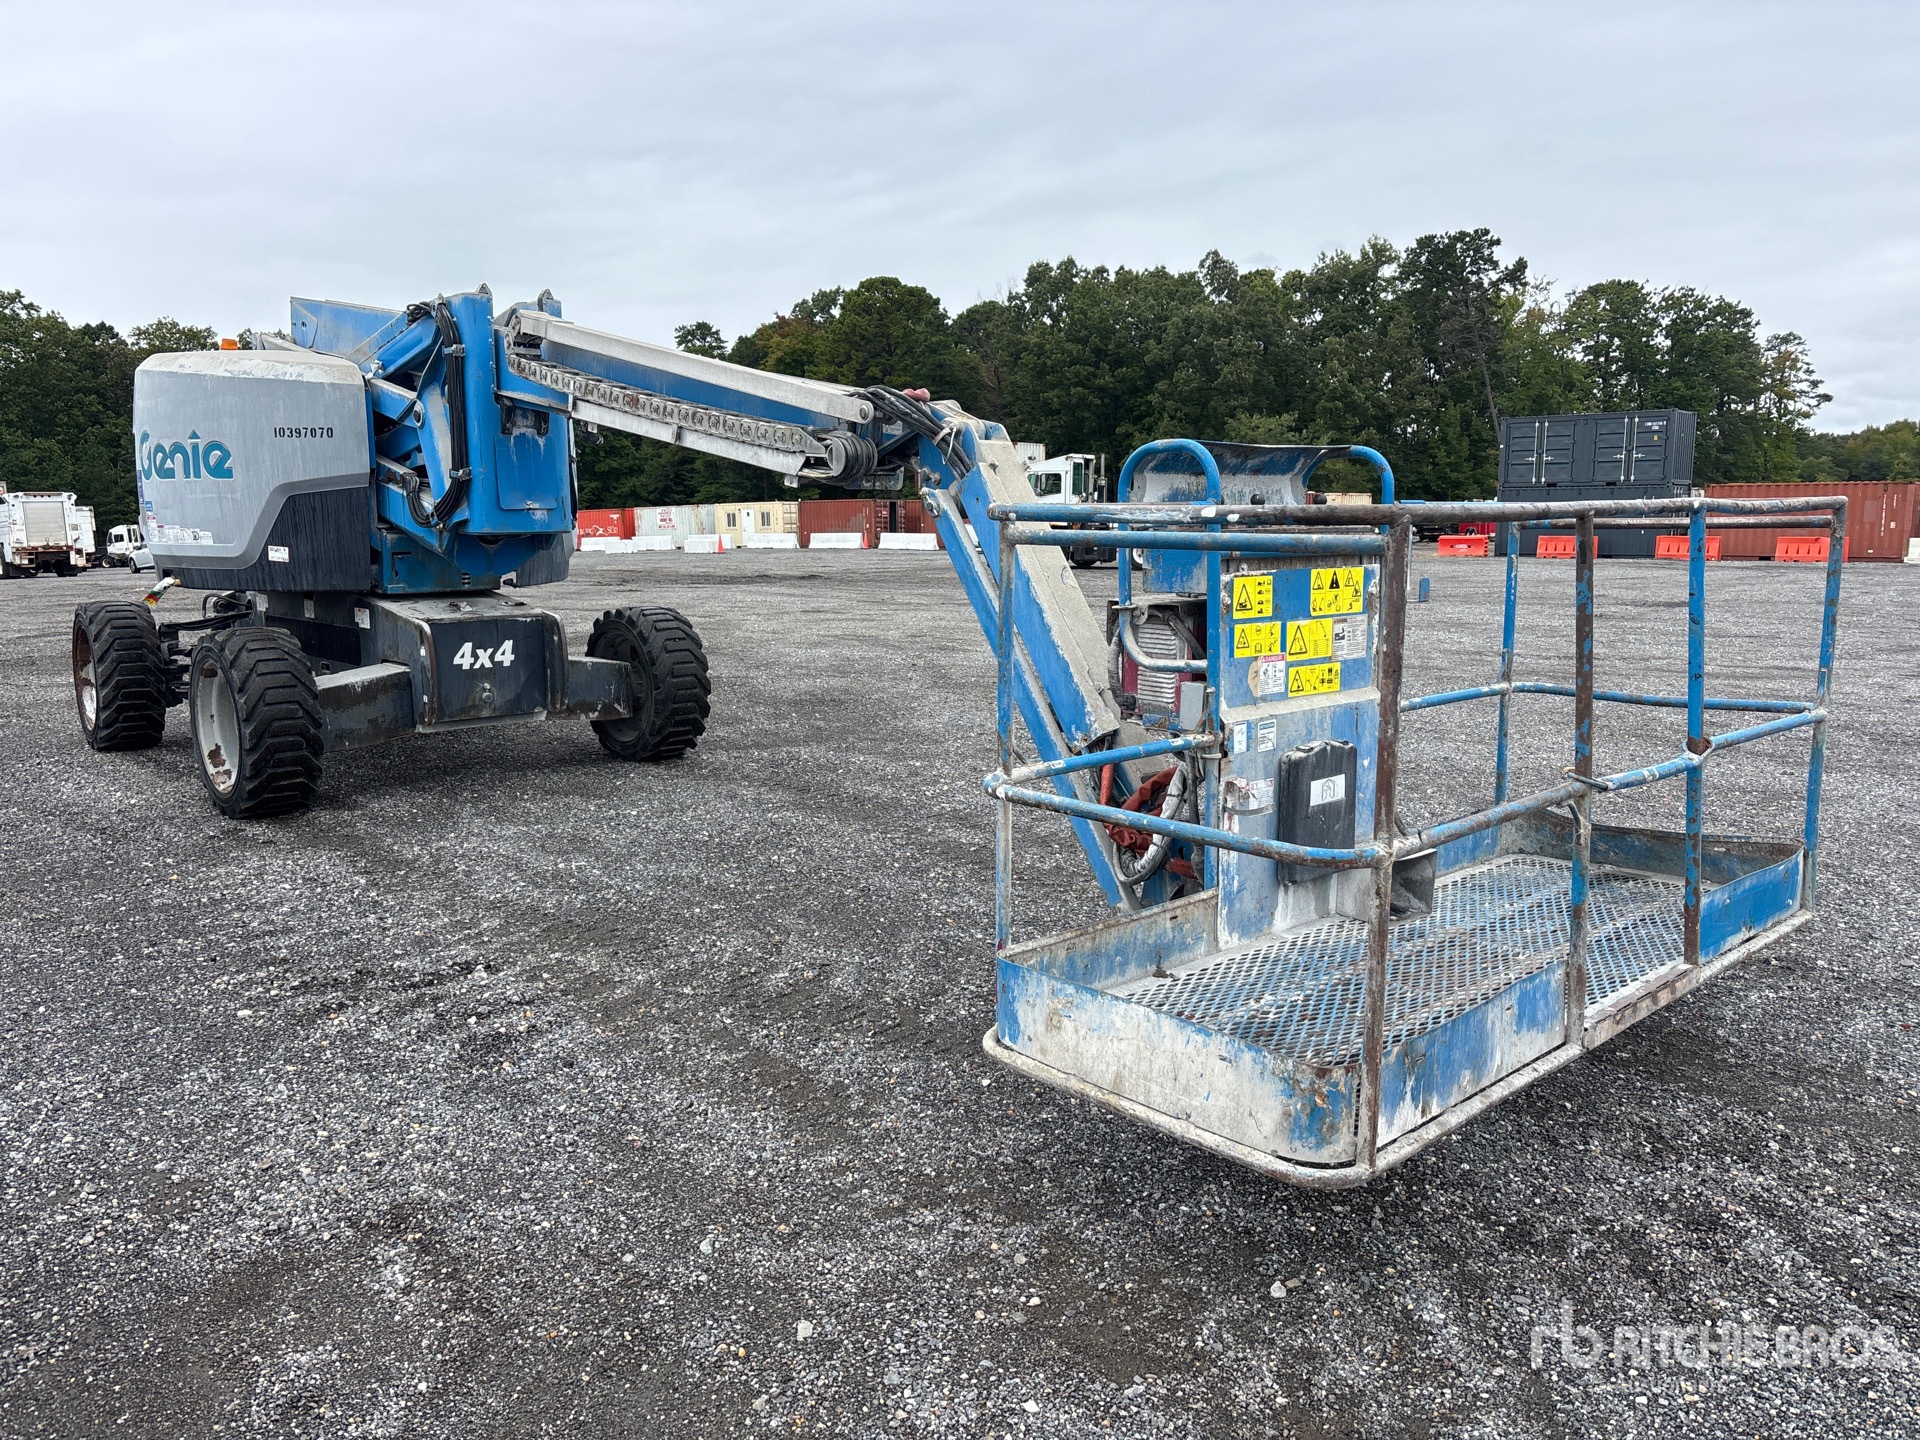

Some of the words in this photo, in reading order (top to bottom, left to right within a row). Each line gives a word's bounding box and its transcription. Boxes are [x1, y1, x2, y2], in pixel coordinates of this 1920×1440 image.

[273, 426, 334, 439] 10397070
[140, 429, 234, 481] Genie
[453, 639, 515, 670] 4x4
